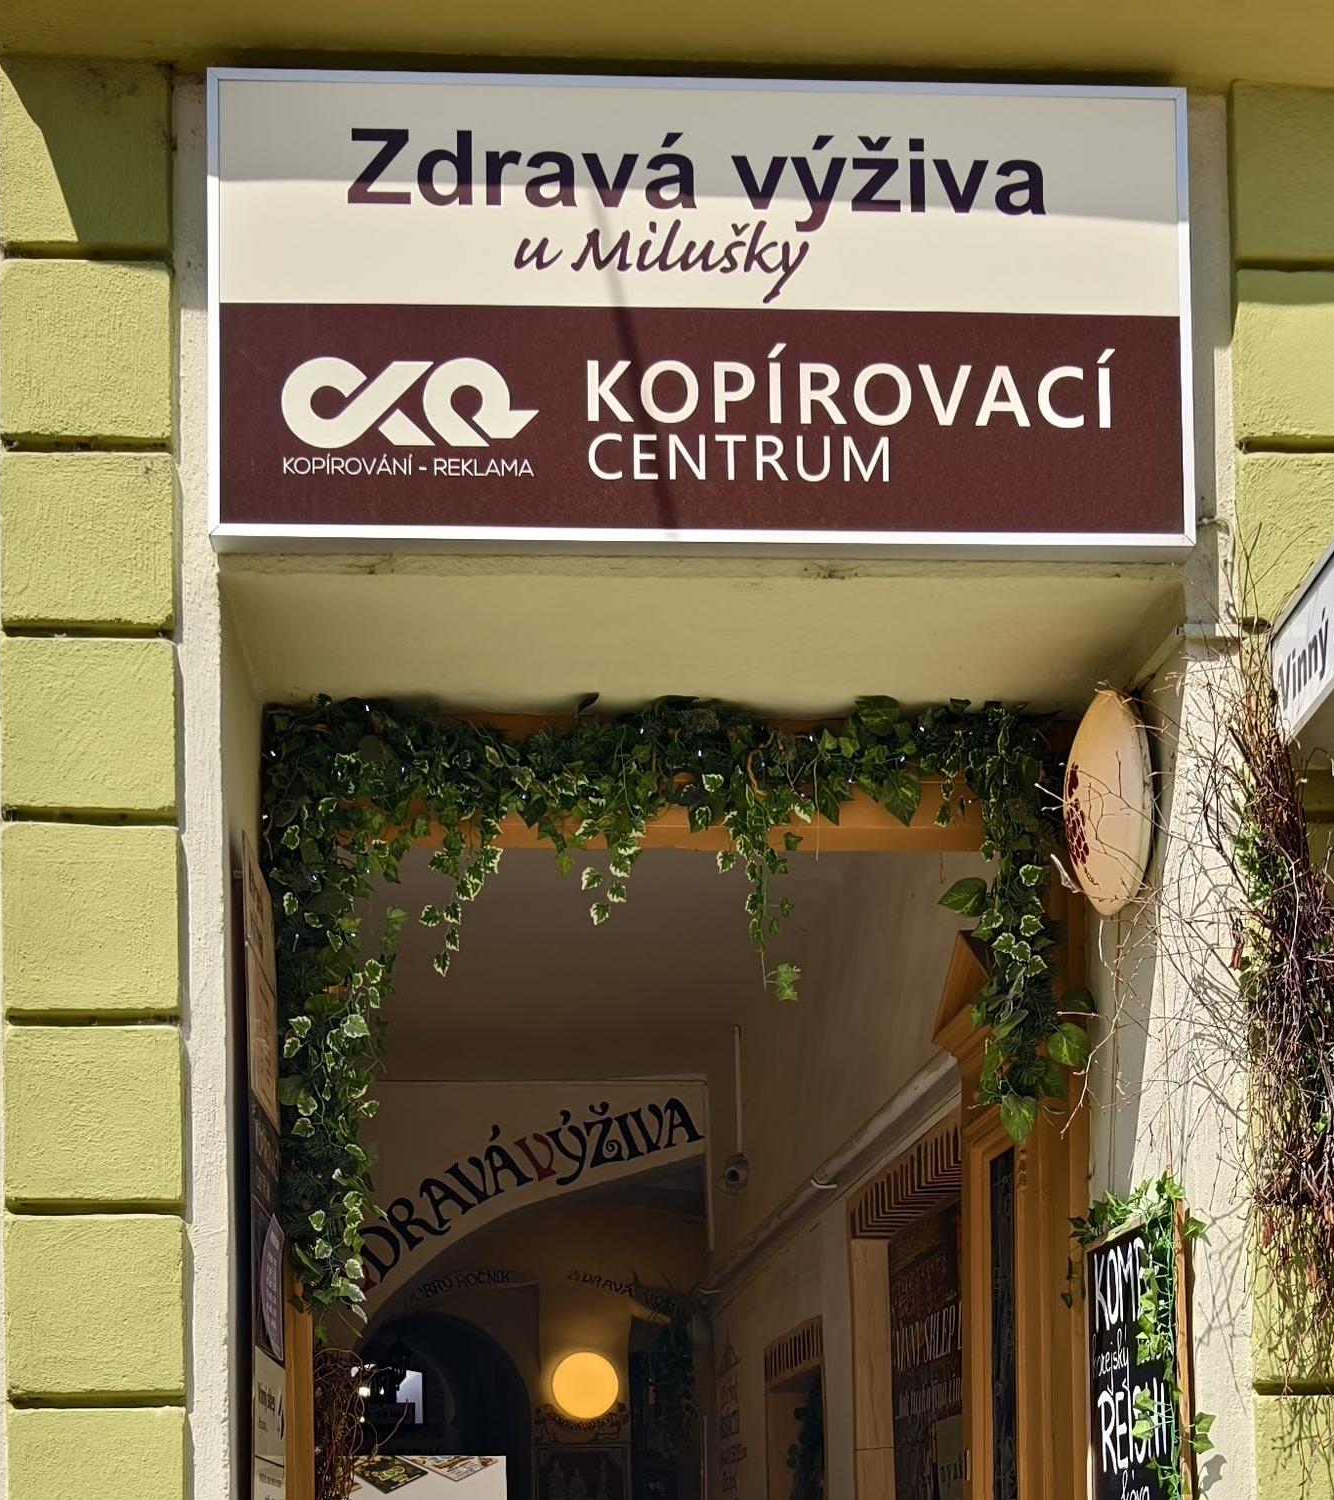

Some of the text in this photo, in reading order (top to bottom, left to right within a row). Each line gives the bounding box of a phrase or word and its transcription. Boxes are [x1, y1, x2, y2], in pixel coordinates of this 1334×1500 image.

[347, 127, 1047, 233] Zdravá výživa
[513, 218, 811, 305] u Milušky
[584, 341, 1114, 430] KOPÍROVACÍ
[282, 452, 535, 478] KOPÍROVÁNÍ REKLAMA
[587, 432, 893, 483] CENTRUM
[1278, 607, 1329, 712] Vinný
[358, 1125, 535, 1291] DRAVÁ
